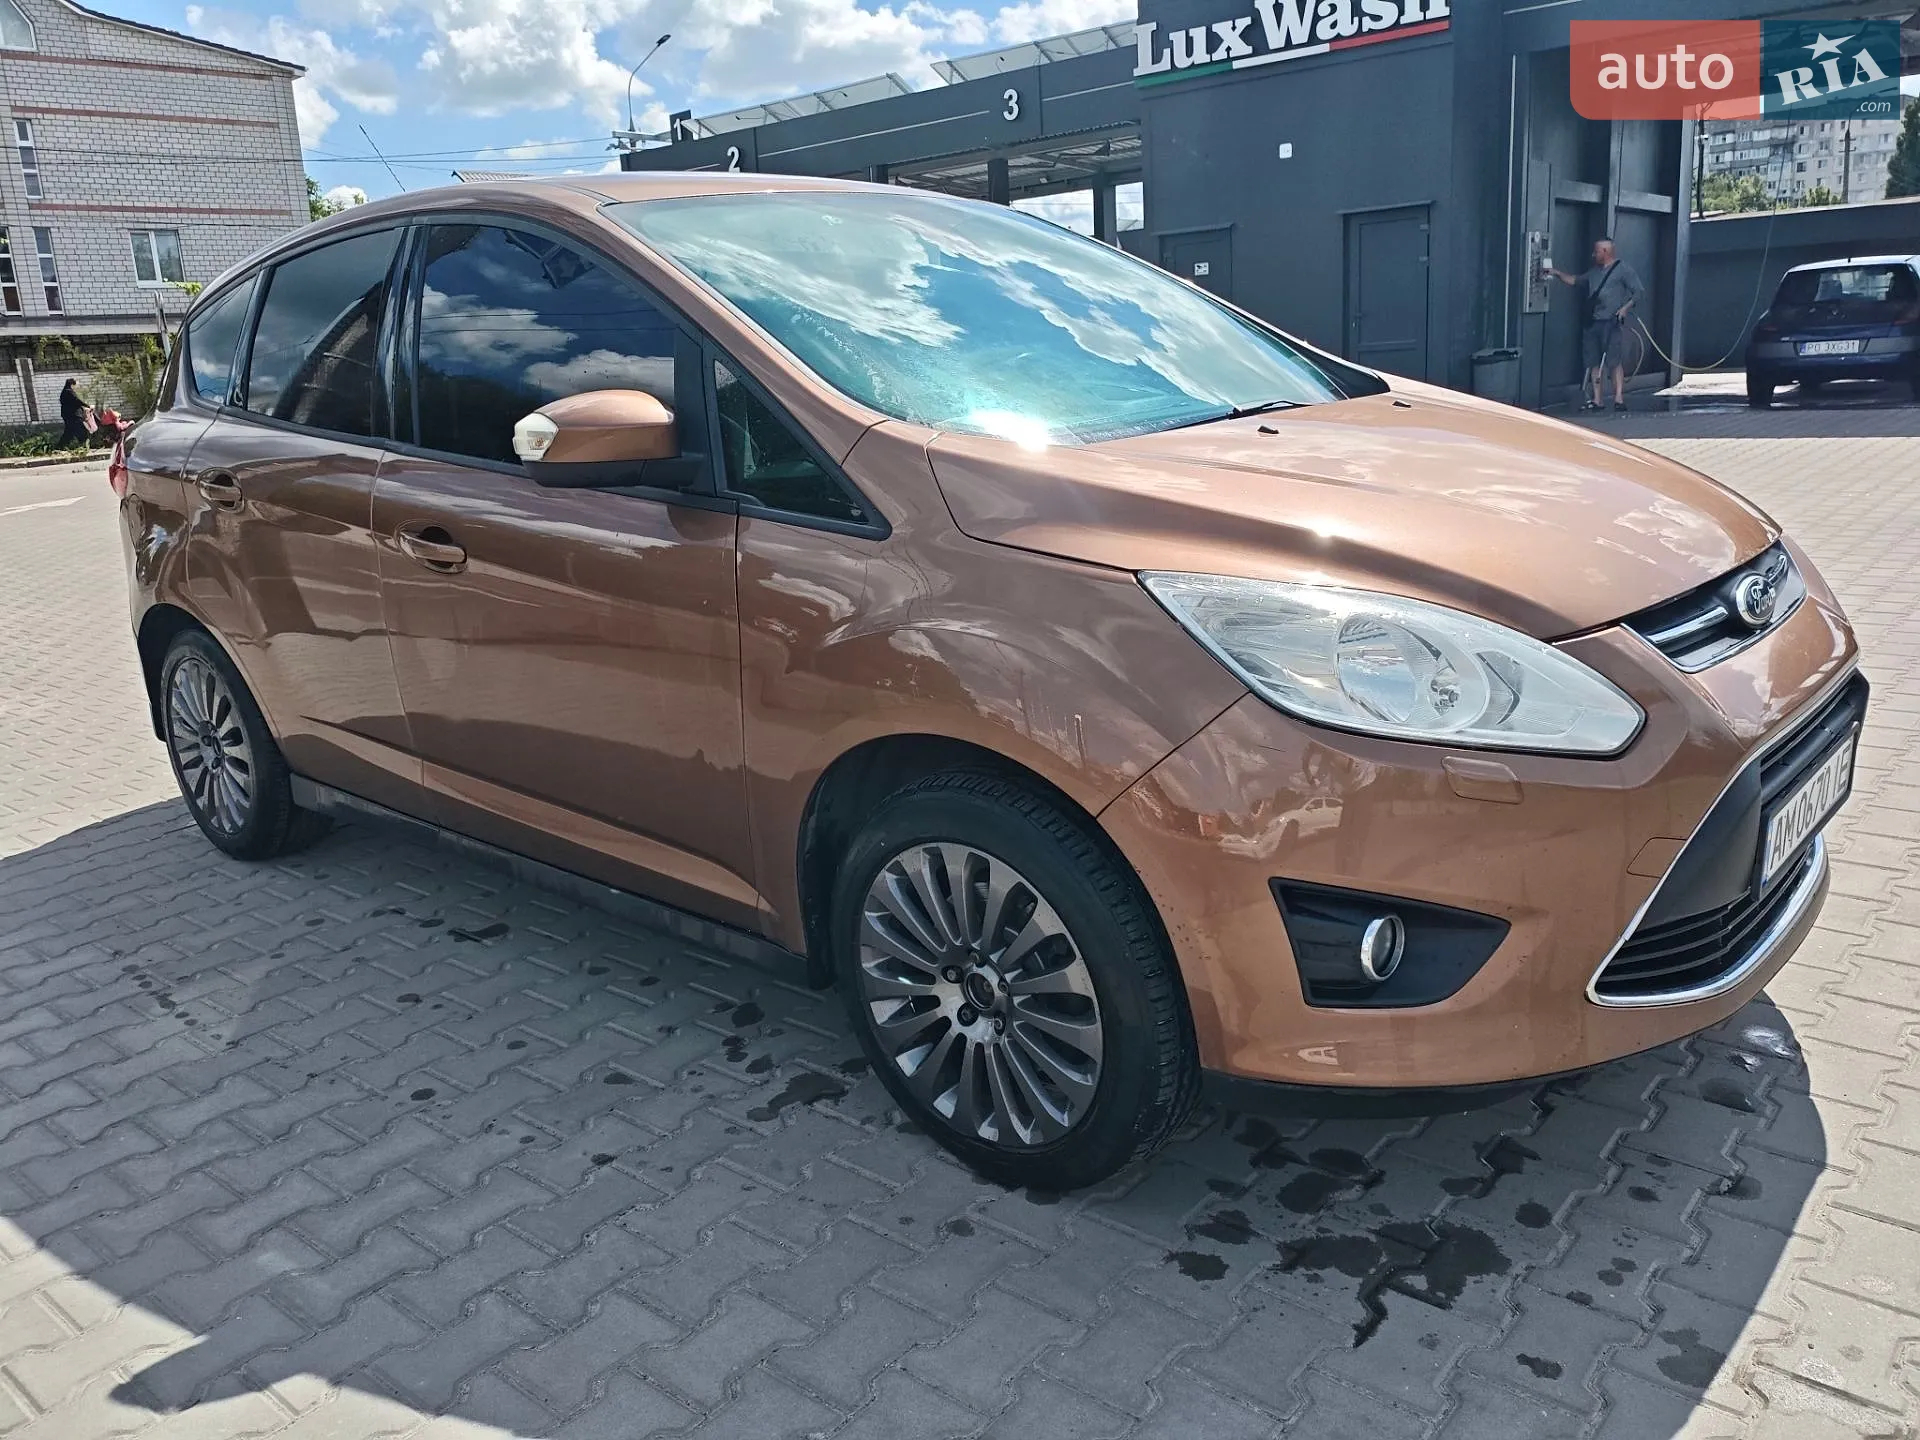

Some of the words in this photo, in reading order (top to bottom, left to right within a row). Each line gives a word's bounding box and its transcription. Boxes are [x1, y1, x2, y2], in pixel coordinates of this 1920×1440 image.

[1132, 17, 1253, 77] Lux
[1003, 88, 1019, 121] 3
[673, 118, 682, 141] 1
[727, 146, 741, 173] 2
